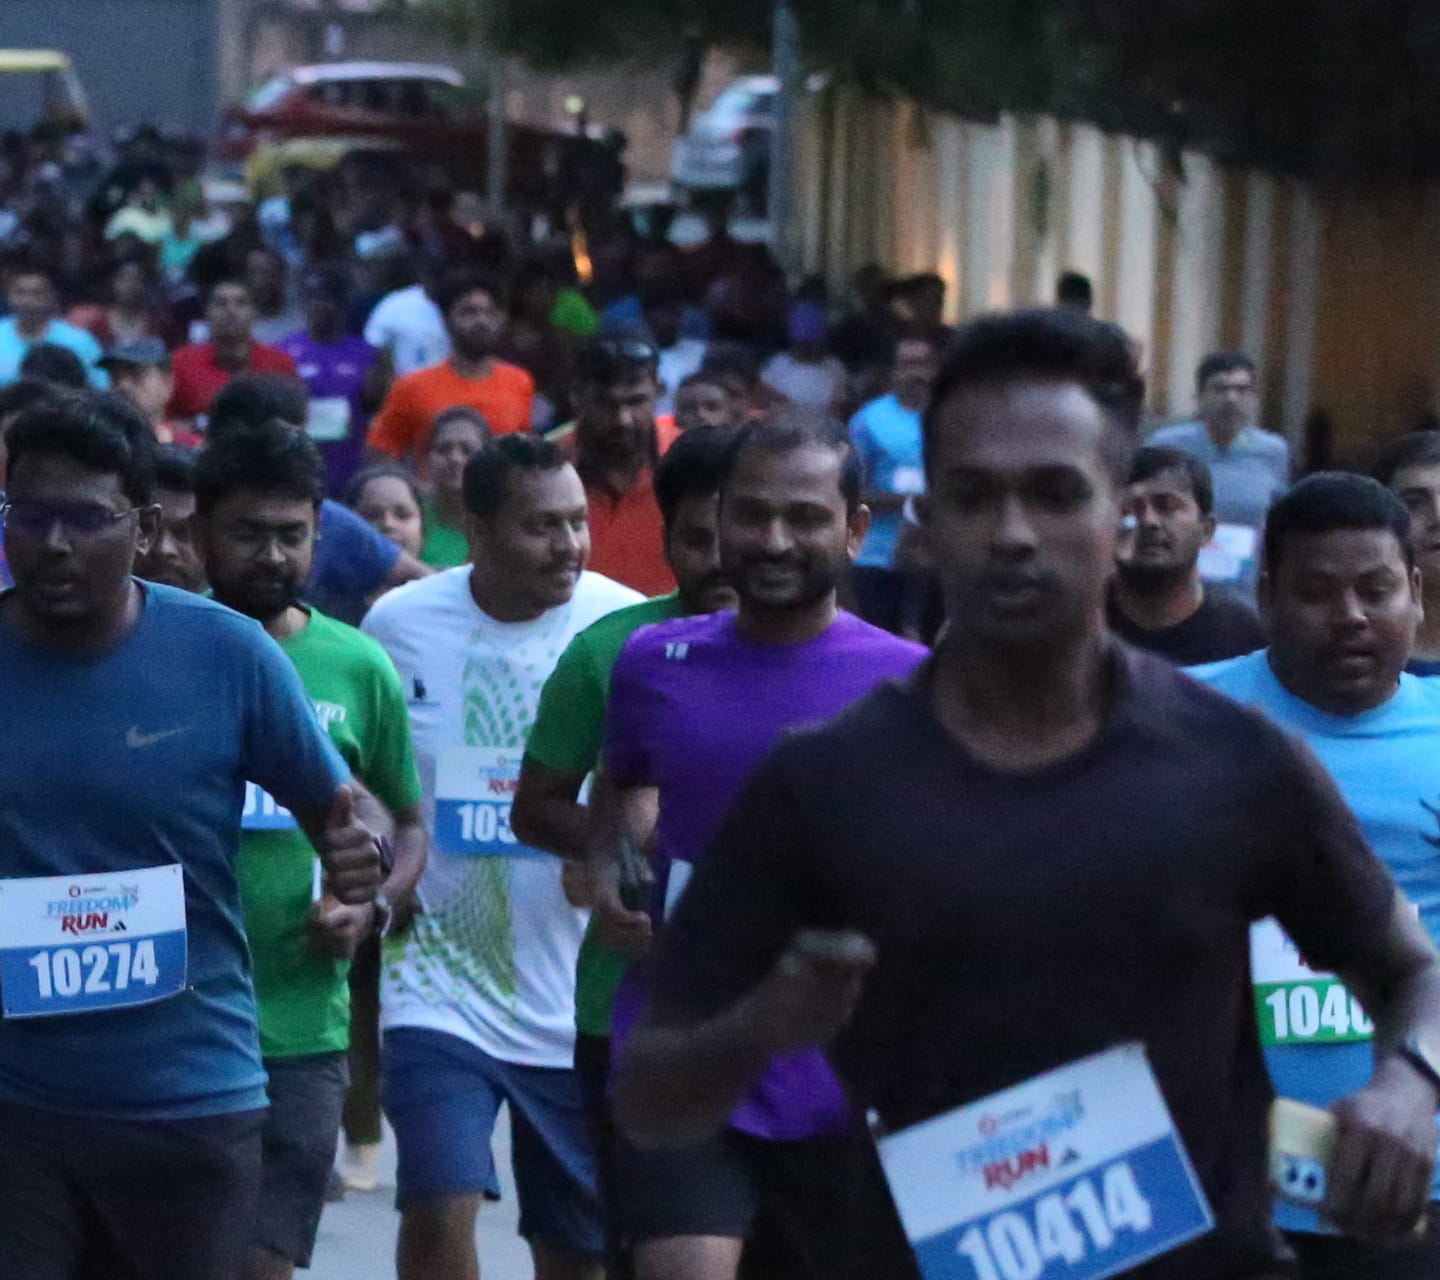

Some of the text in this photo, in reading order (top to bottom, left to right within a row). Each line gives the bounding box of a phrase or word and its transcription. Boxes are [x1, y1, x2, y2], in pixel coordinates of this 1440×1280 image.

[46, 894, 130, 916] FREEDOM
[61, 911, 109, 936] RUN
[29, 938, 160, 999] 10274
[983, 1141, 1050, 1192] RUN
